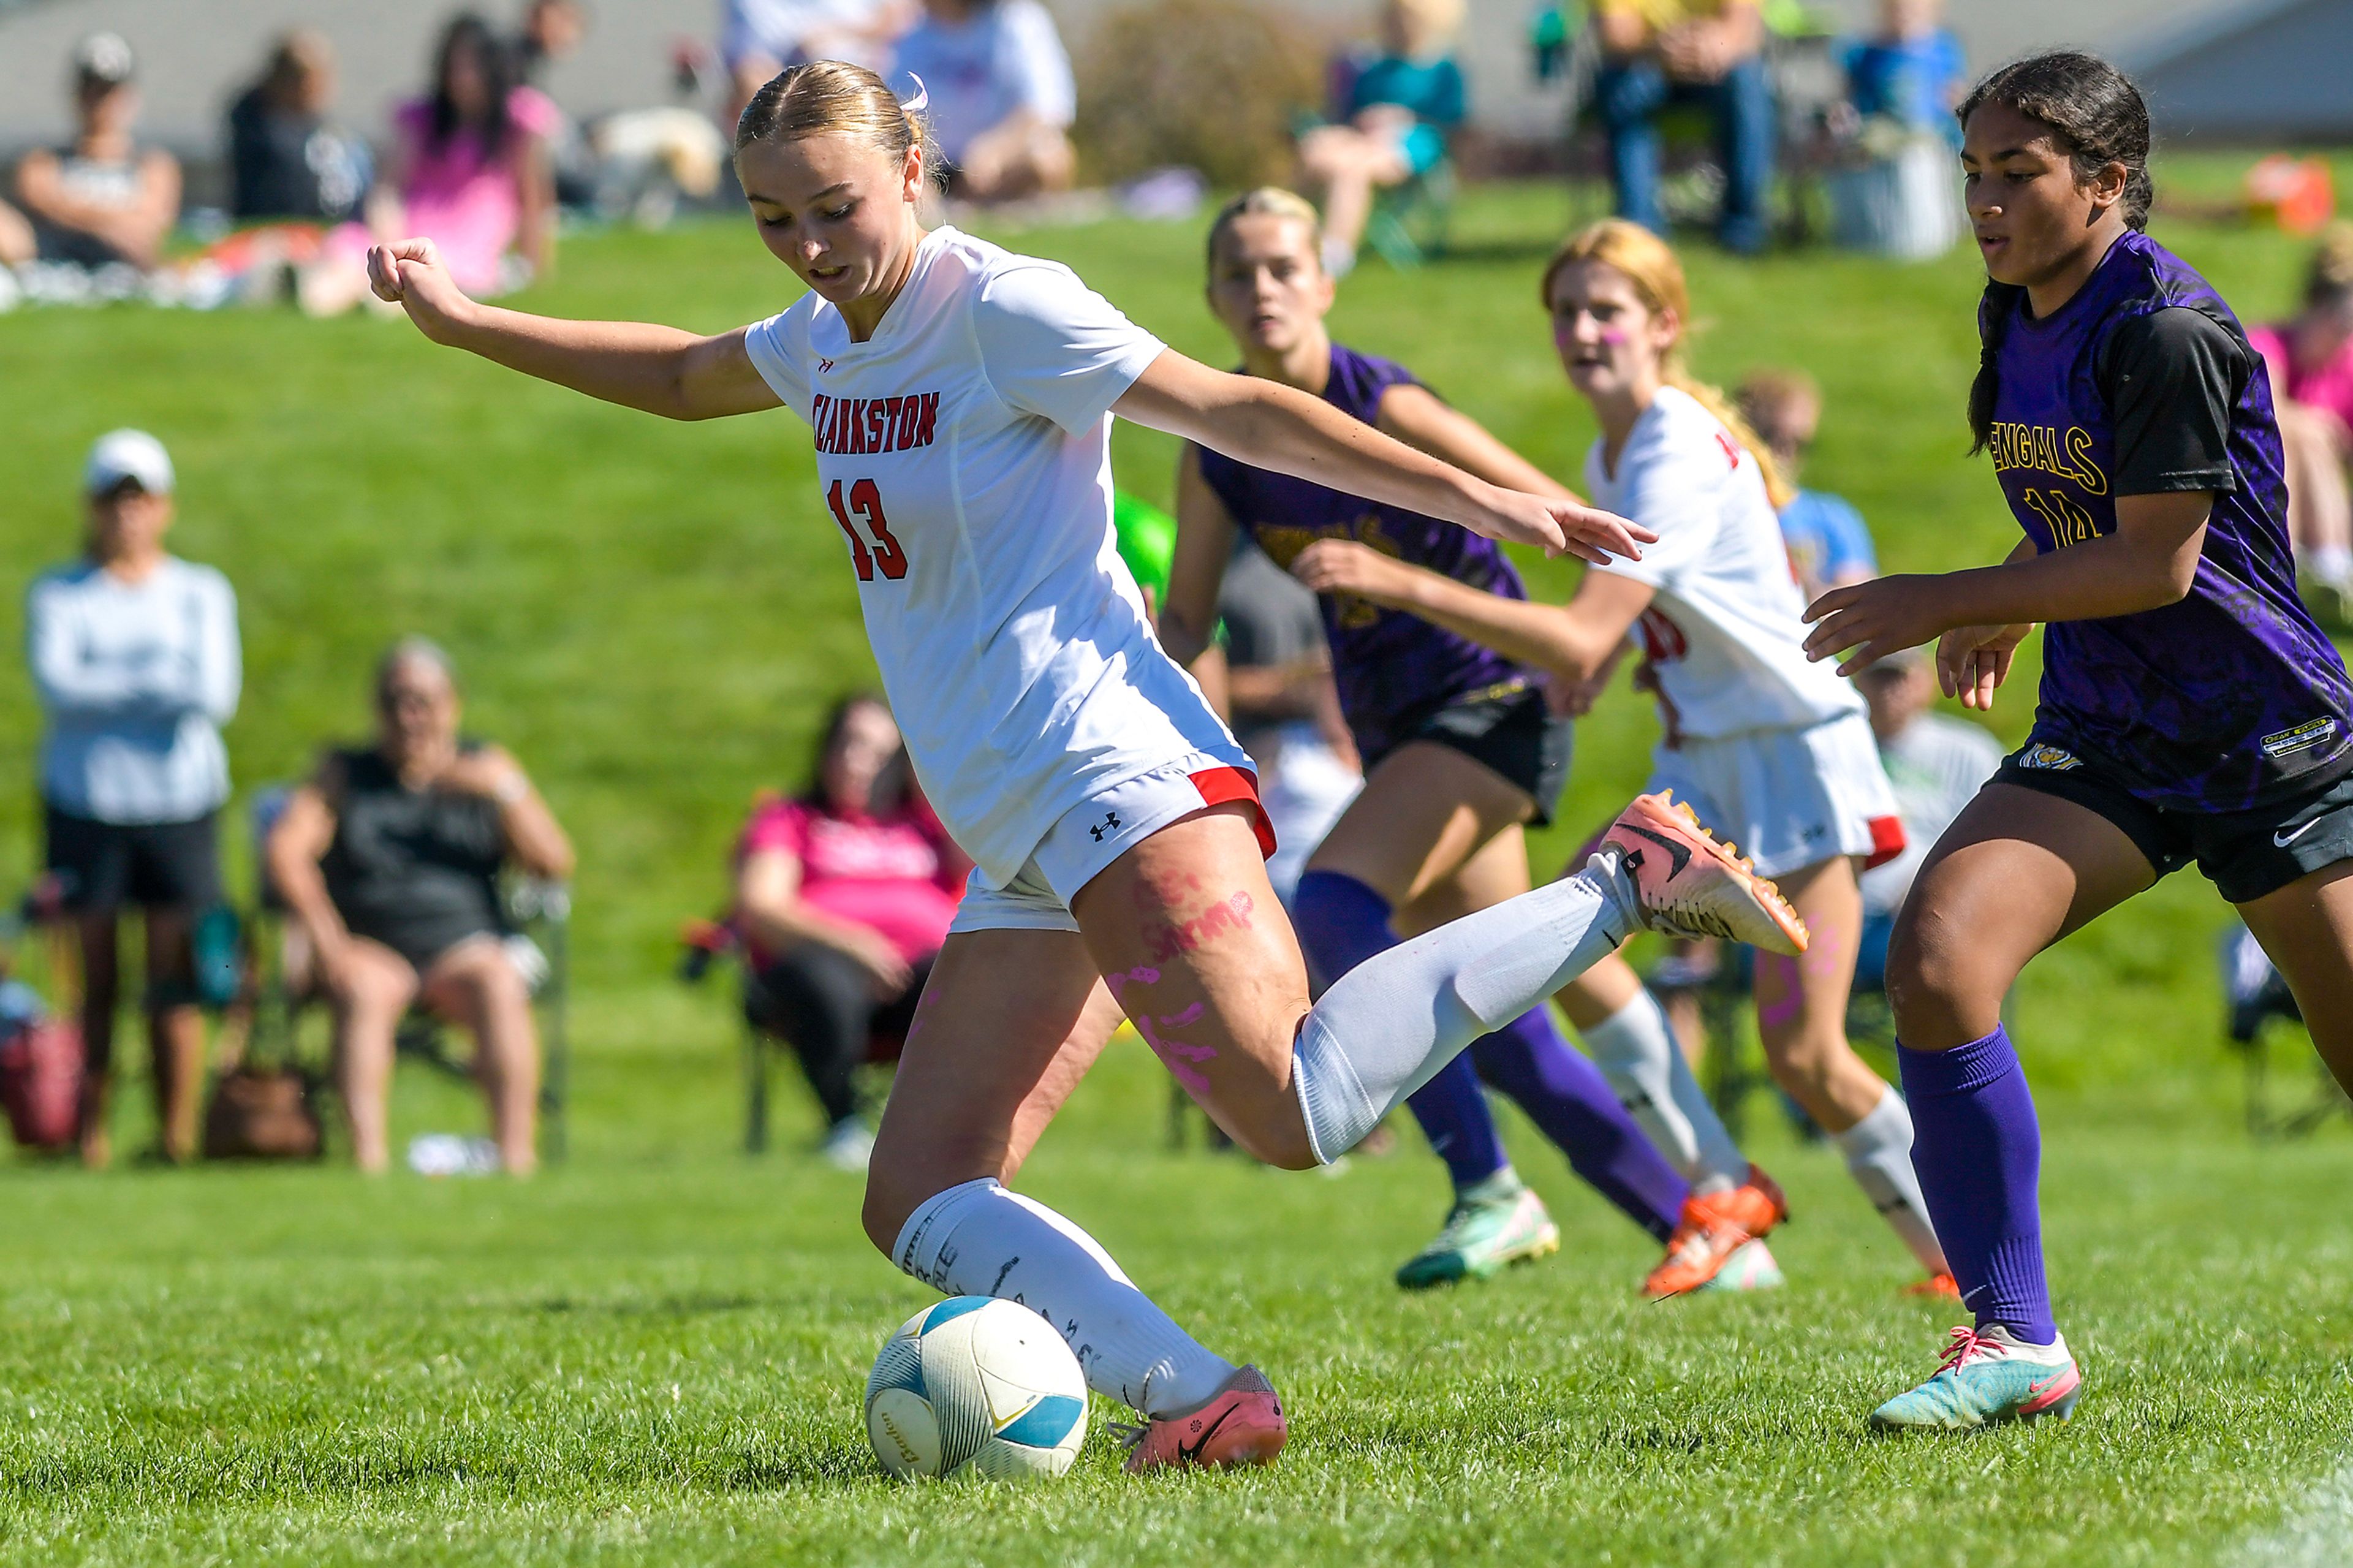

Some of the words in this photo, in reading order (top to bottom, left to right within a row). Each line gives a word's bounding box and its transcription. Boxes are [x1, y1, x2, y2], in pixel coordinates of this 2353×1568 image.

[813, 391, 940, 454] CLARKSTON
[827, 479, 908, 581] 13
[2024, 488, 2103, 550] 14
[880, 1412, 920, 1465] Baden
